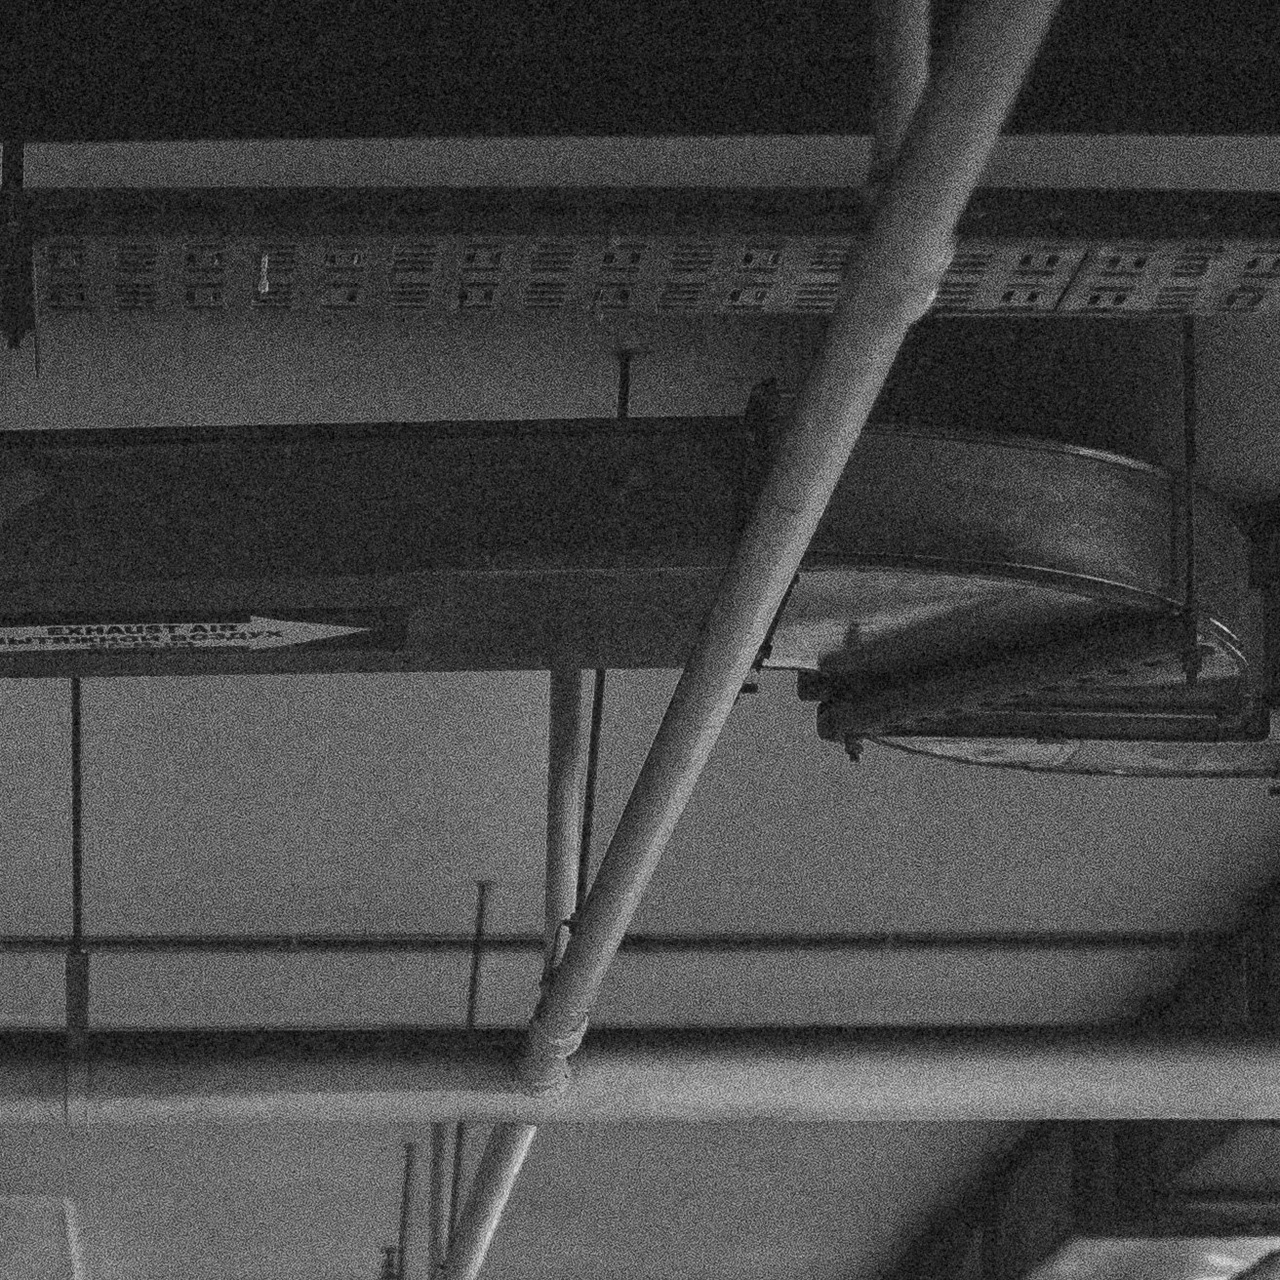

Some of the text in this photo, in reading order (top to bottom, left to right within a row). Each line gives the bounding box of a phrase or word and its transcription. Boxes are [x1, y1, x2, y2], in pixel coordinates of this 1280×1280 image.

[47, 624, 237, 635] EXHAUST AIR
[170, 631, 282, 642] ВОЗДУХ
